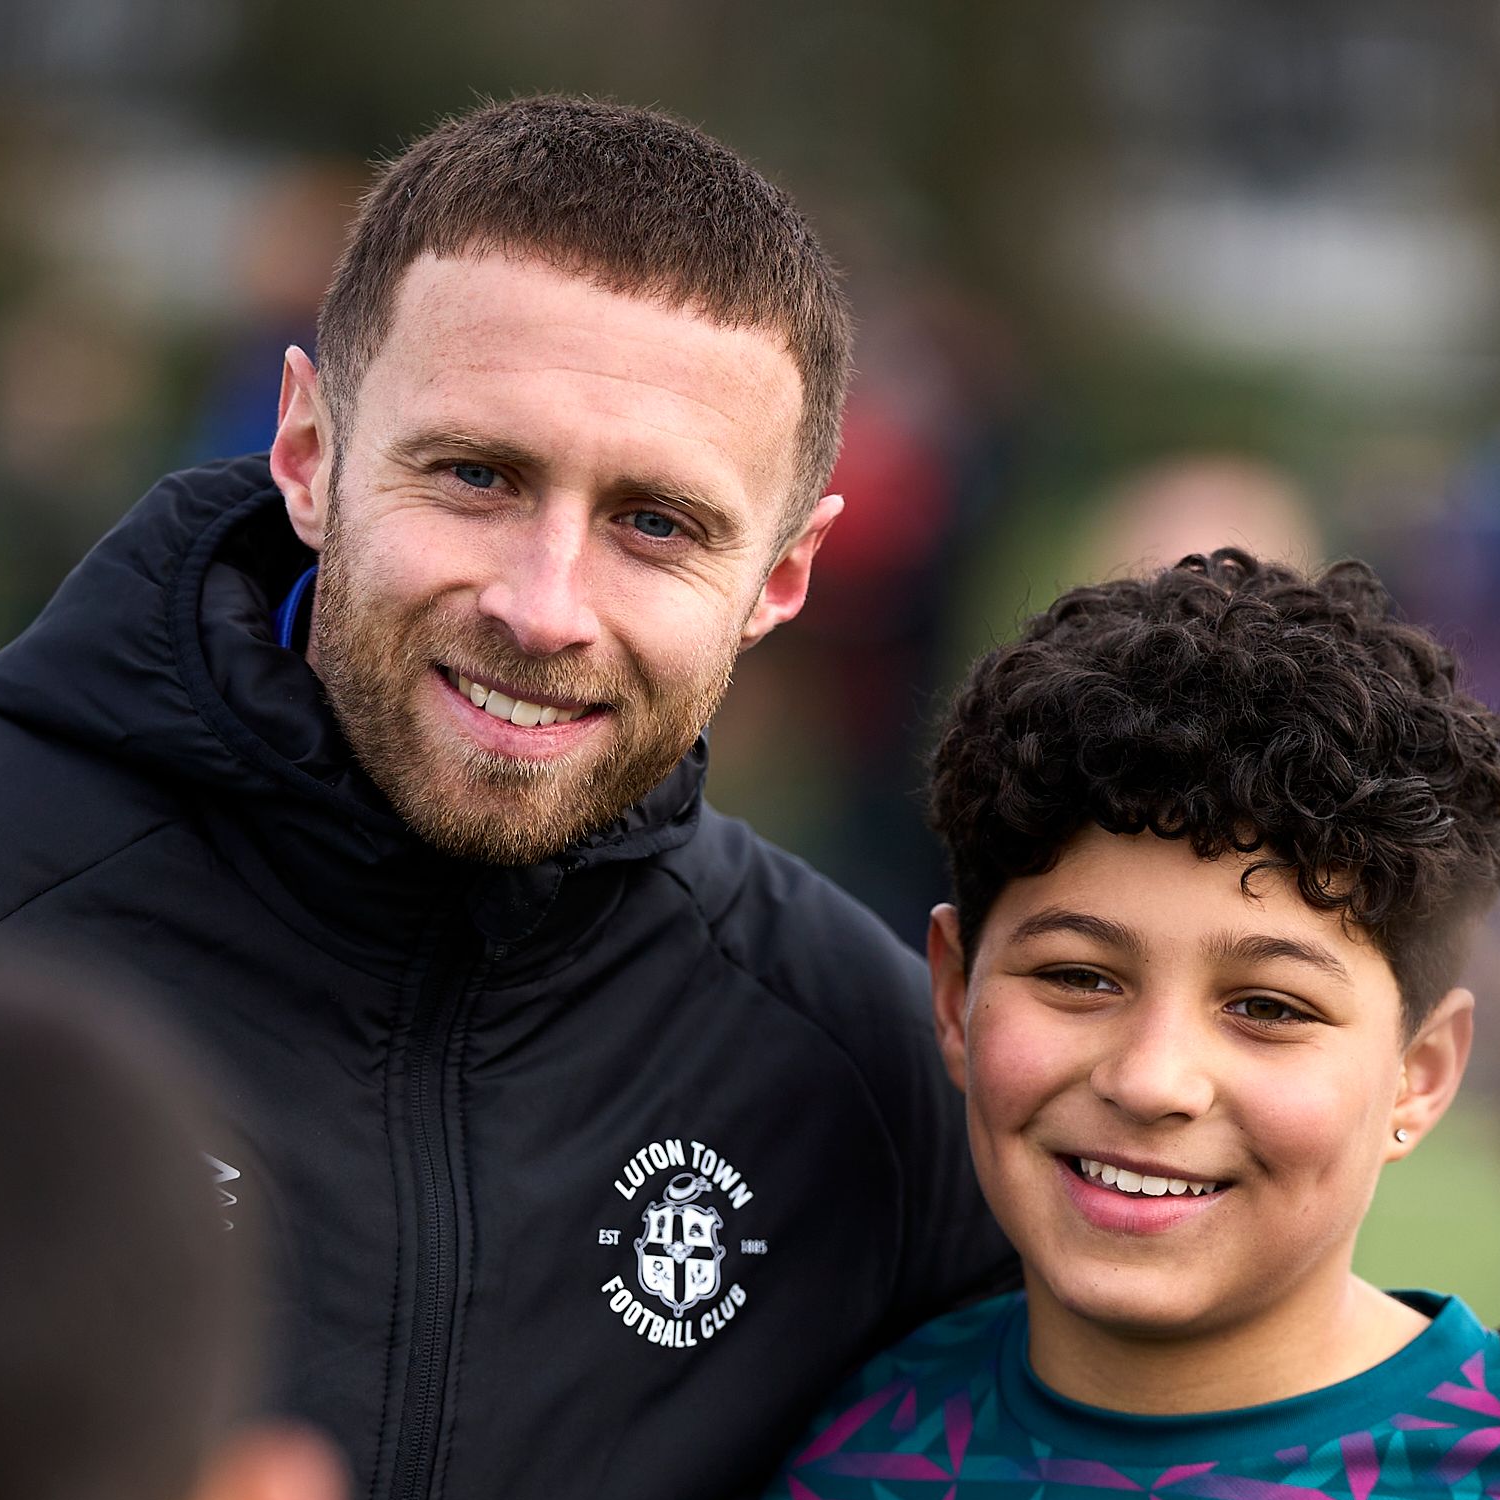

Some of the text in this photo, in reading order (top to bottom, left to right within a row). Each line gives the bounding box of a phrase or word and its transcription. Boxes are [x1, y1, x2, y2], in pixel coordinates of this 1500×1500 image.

[613, 1138, 754, 1210] LUTON TOWN
[598, 1229, 621, 1246] EST
[601, 1275, 747, 1348] FOOTBALL CLUB
